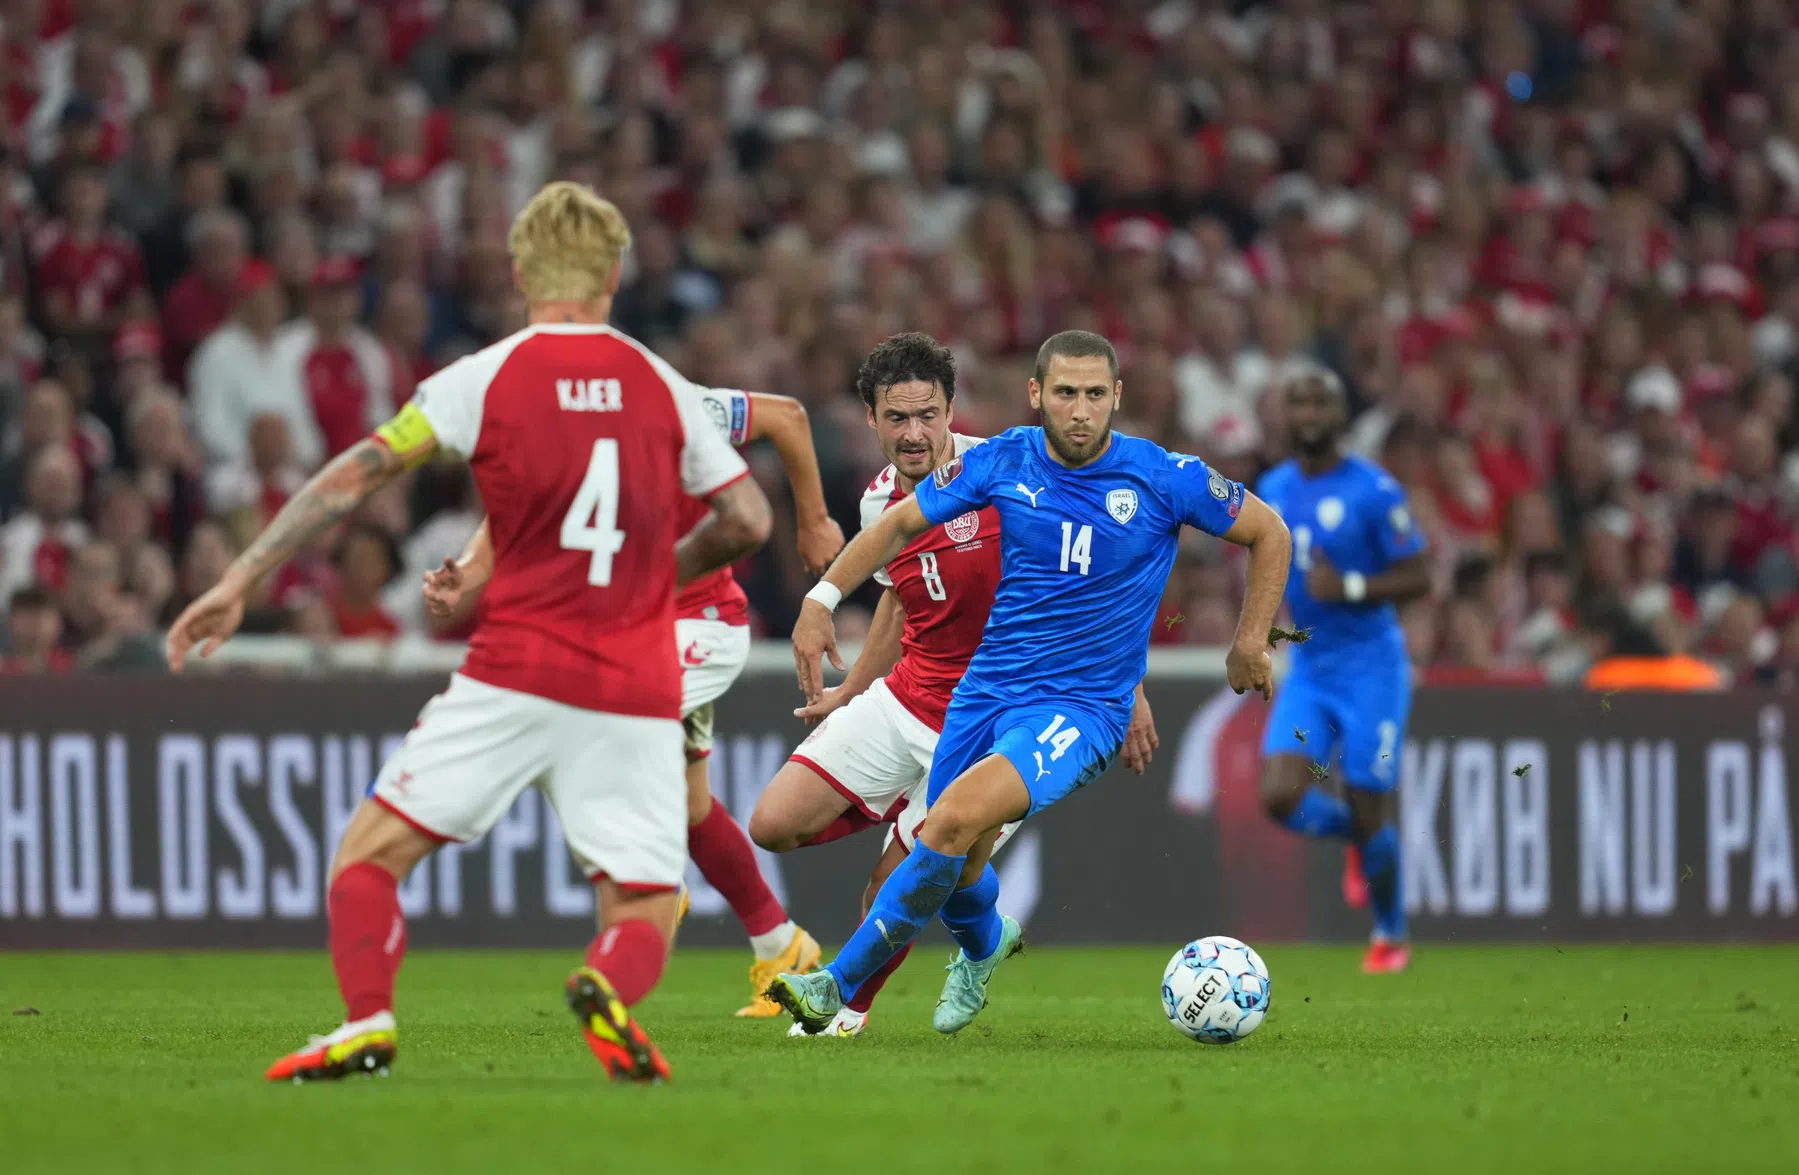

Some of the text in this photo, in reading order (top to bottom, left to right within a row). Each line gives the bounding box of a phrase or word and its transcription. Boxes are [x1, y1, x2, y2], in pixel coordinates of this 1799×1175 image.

[560, 438, 626, 587] 4
[952, 516, 972, 529] DBU
[1060, 521, 1093, 575] 14
[917, 552, 947, 601] 8
[1036, 714, 1081, 762] 14
[1401, 704, 1798, 917] KØB NU PÅ
[1183, 975, 1221, 1024] SELECT
